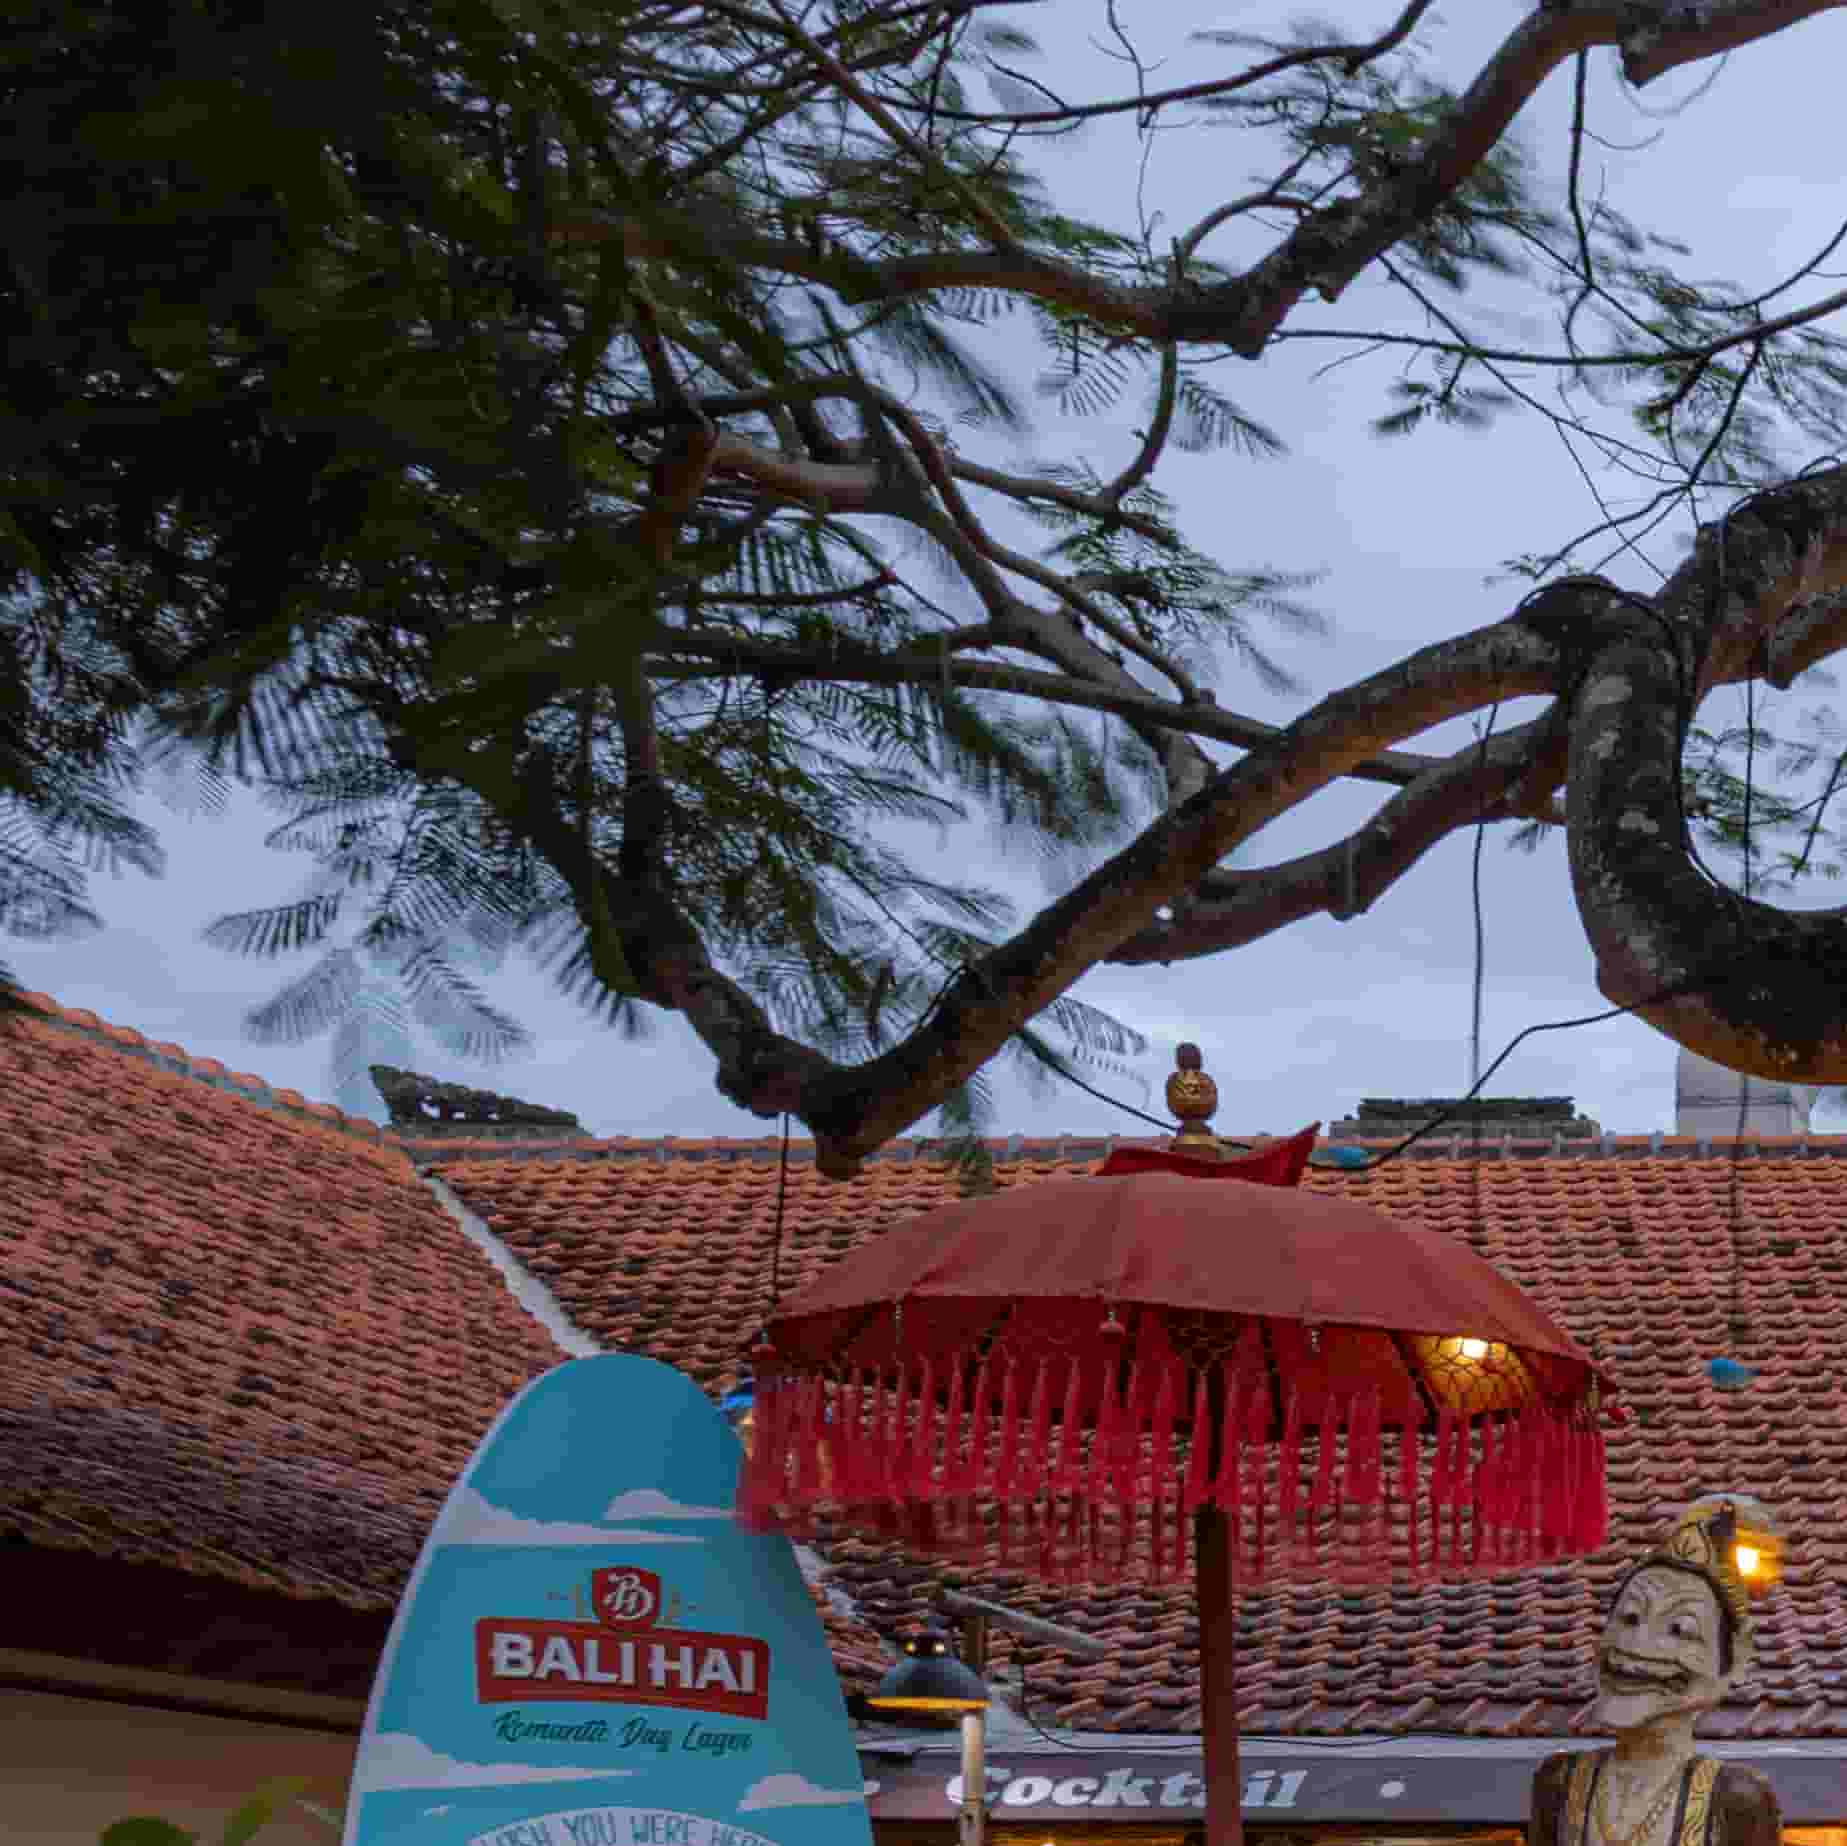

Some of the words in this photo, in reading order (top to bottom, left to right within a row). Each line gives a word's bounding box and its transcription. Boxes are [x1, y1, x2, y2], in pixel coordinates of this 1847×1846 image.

[491, 1631, 637, 1685] BALI
[648, 1642, 757, 1693] HAI
[945, 1764, 1308, 1809] Cocktil
